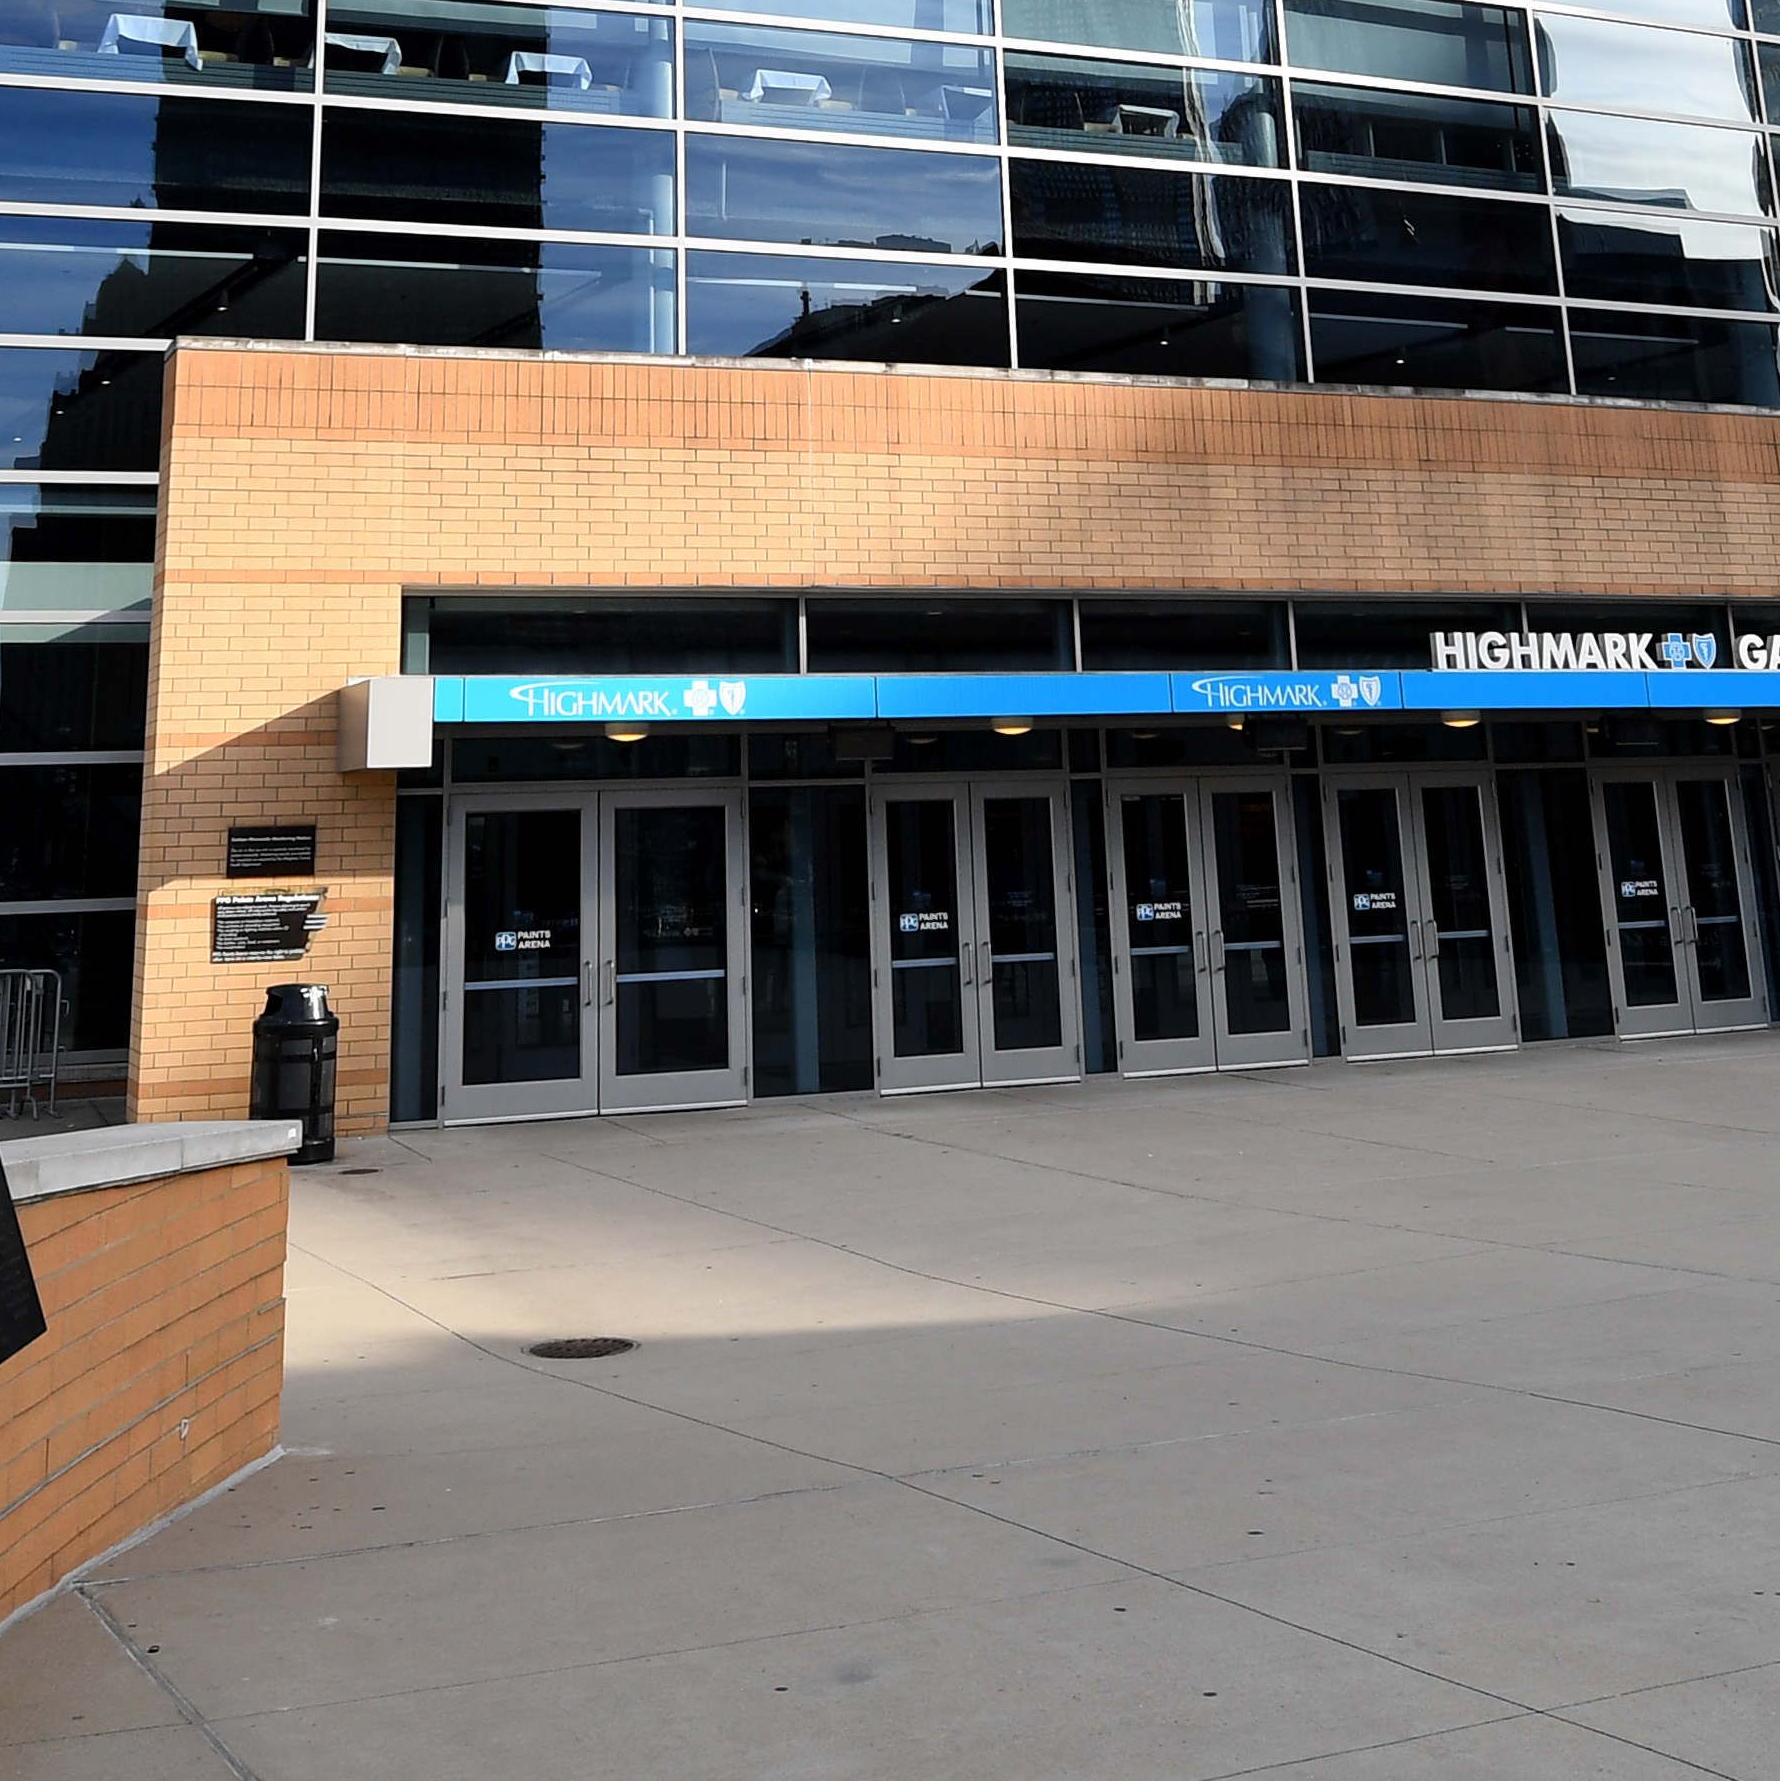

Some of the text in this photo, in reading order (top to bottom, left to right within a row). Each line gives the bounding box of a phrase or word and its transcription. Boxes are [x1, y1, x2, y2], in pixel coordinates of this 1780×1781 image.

[1431, 631, 1659, 670] HIGHMARK
[1192, 676, 1323, 707] HIGHMARK
[509, 681, 672, 717] HIGHMARK
[1154, 902, 1181, 911] PAINTS
[919, 912, 948, 921] PAINTS
[1155, 911, 1182, 919] ARENA
[920, 922, 948, 930] ARENA
[517, 930, 551, 940] PAINTS
[518, 940, 551, 949] ARENA
